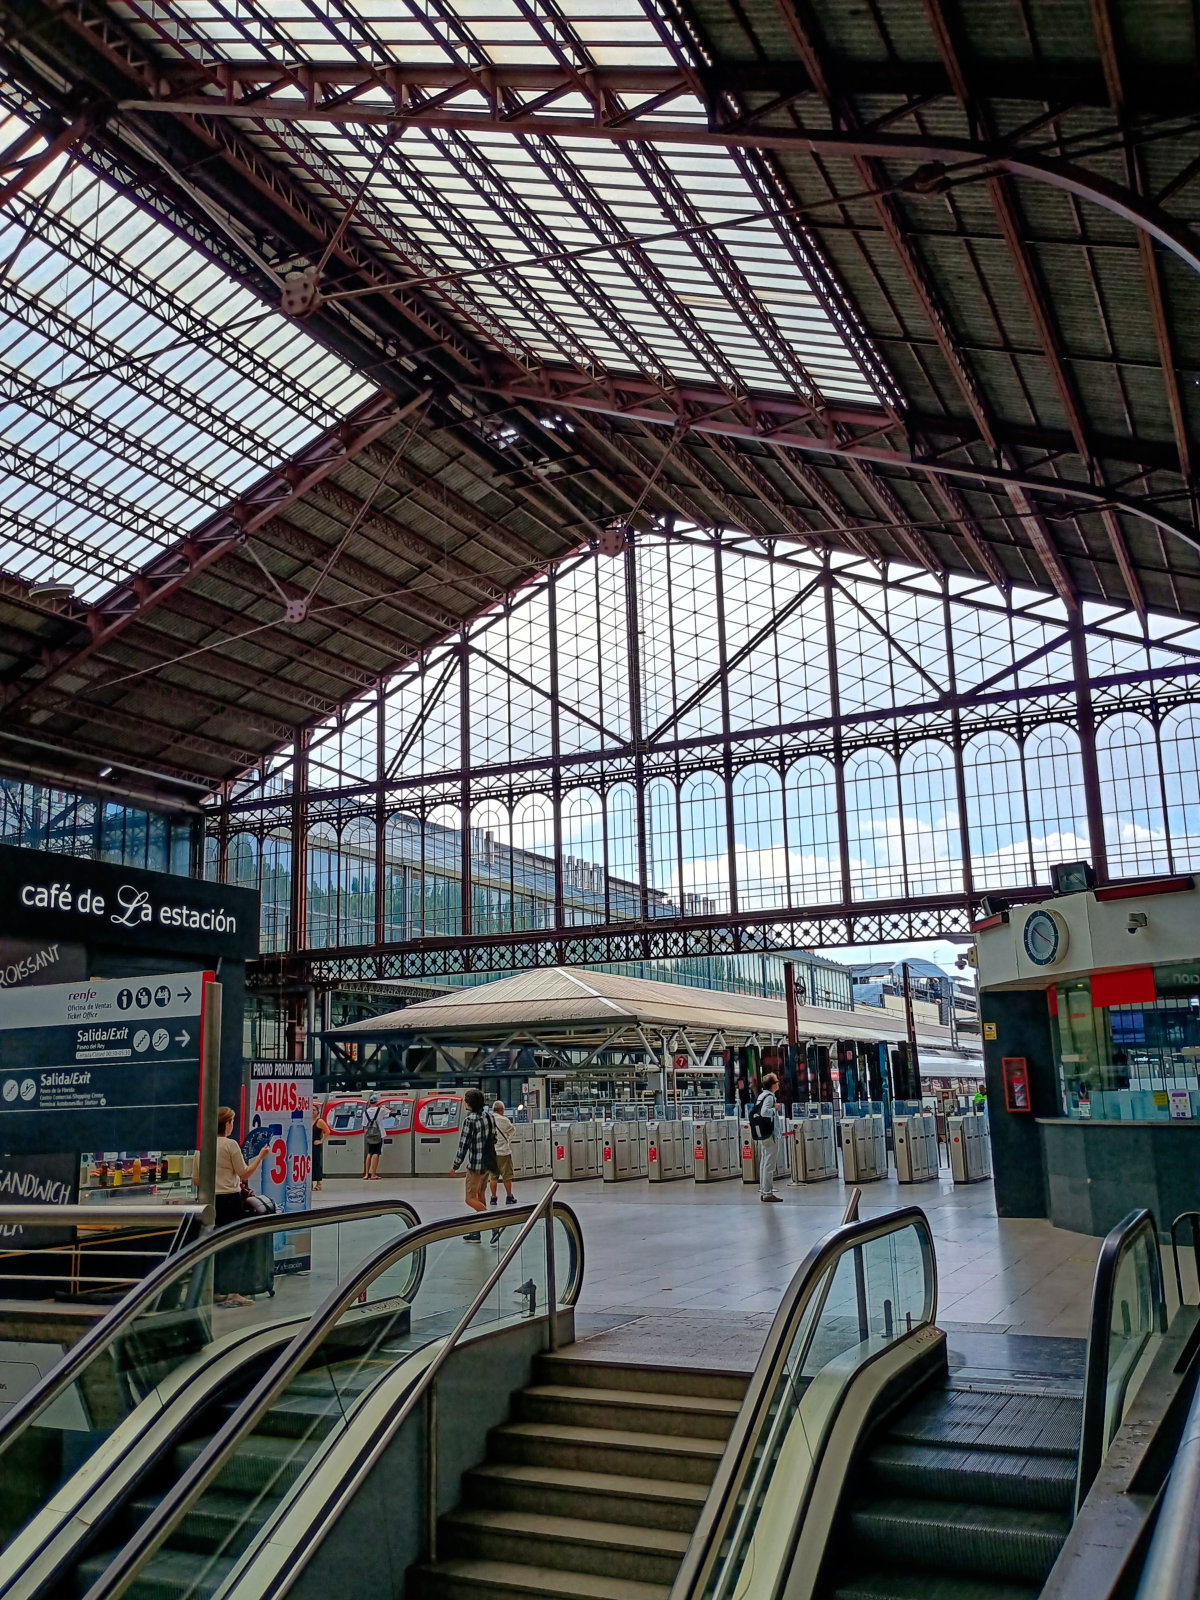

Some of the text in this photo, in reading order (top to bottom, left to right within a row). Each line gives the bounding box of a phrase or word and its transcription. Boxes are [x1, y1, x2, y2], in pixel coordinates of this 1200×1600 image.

[21, 883, 237, 933] café de La estación
[68, 988, 97, 1002] renfe
[67, 1004, 86, 1012] Oficina
[95, 1002, 112, 1010] Ventas
[83, 1012, 98, 1020] Office
[77, 1026, 129, 1042] Salida/Exit
[679, 1057, 684, 1066] 7
[253, 1063, 313, 1077] PROMO PROMO PROMO
[40, 1071, 92, 1086] Salida/Exit
[255, 1082, 310, 1112] AGUAS 50cl
[0, 1170, 71, 1205] ANDWICH
